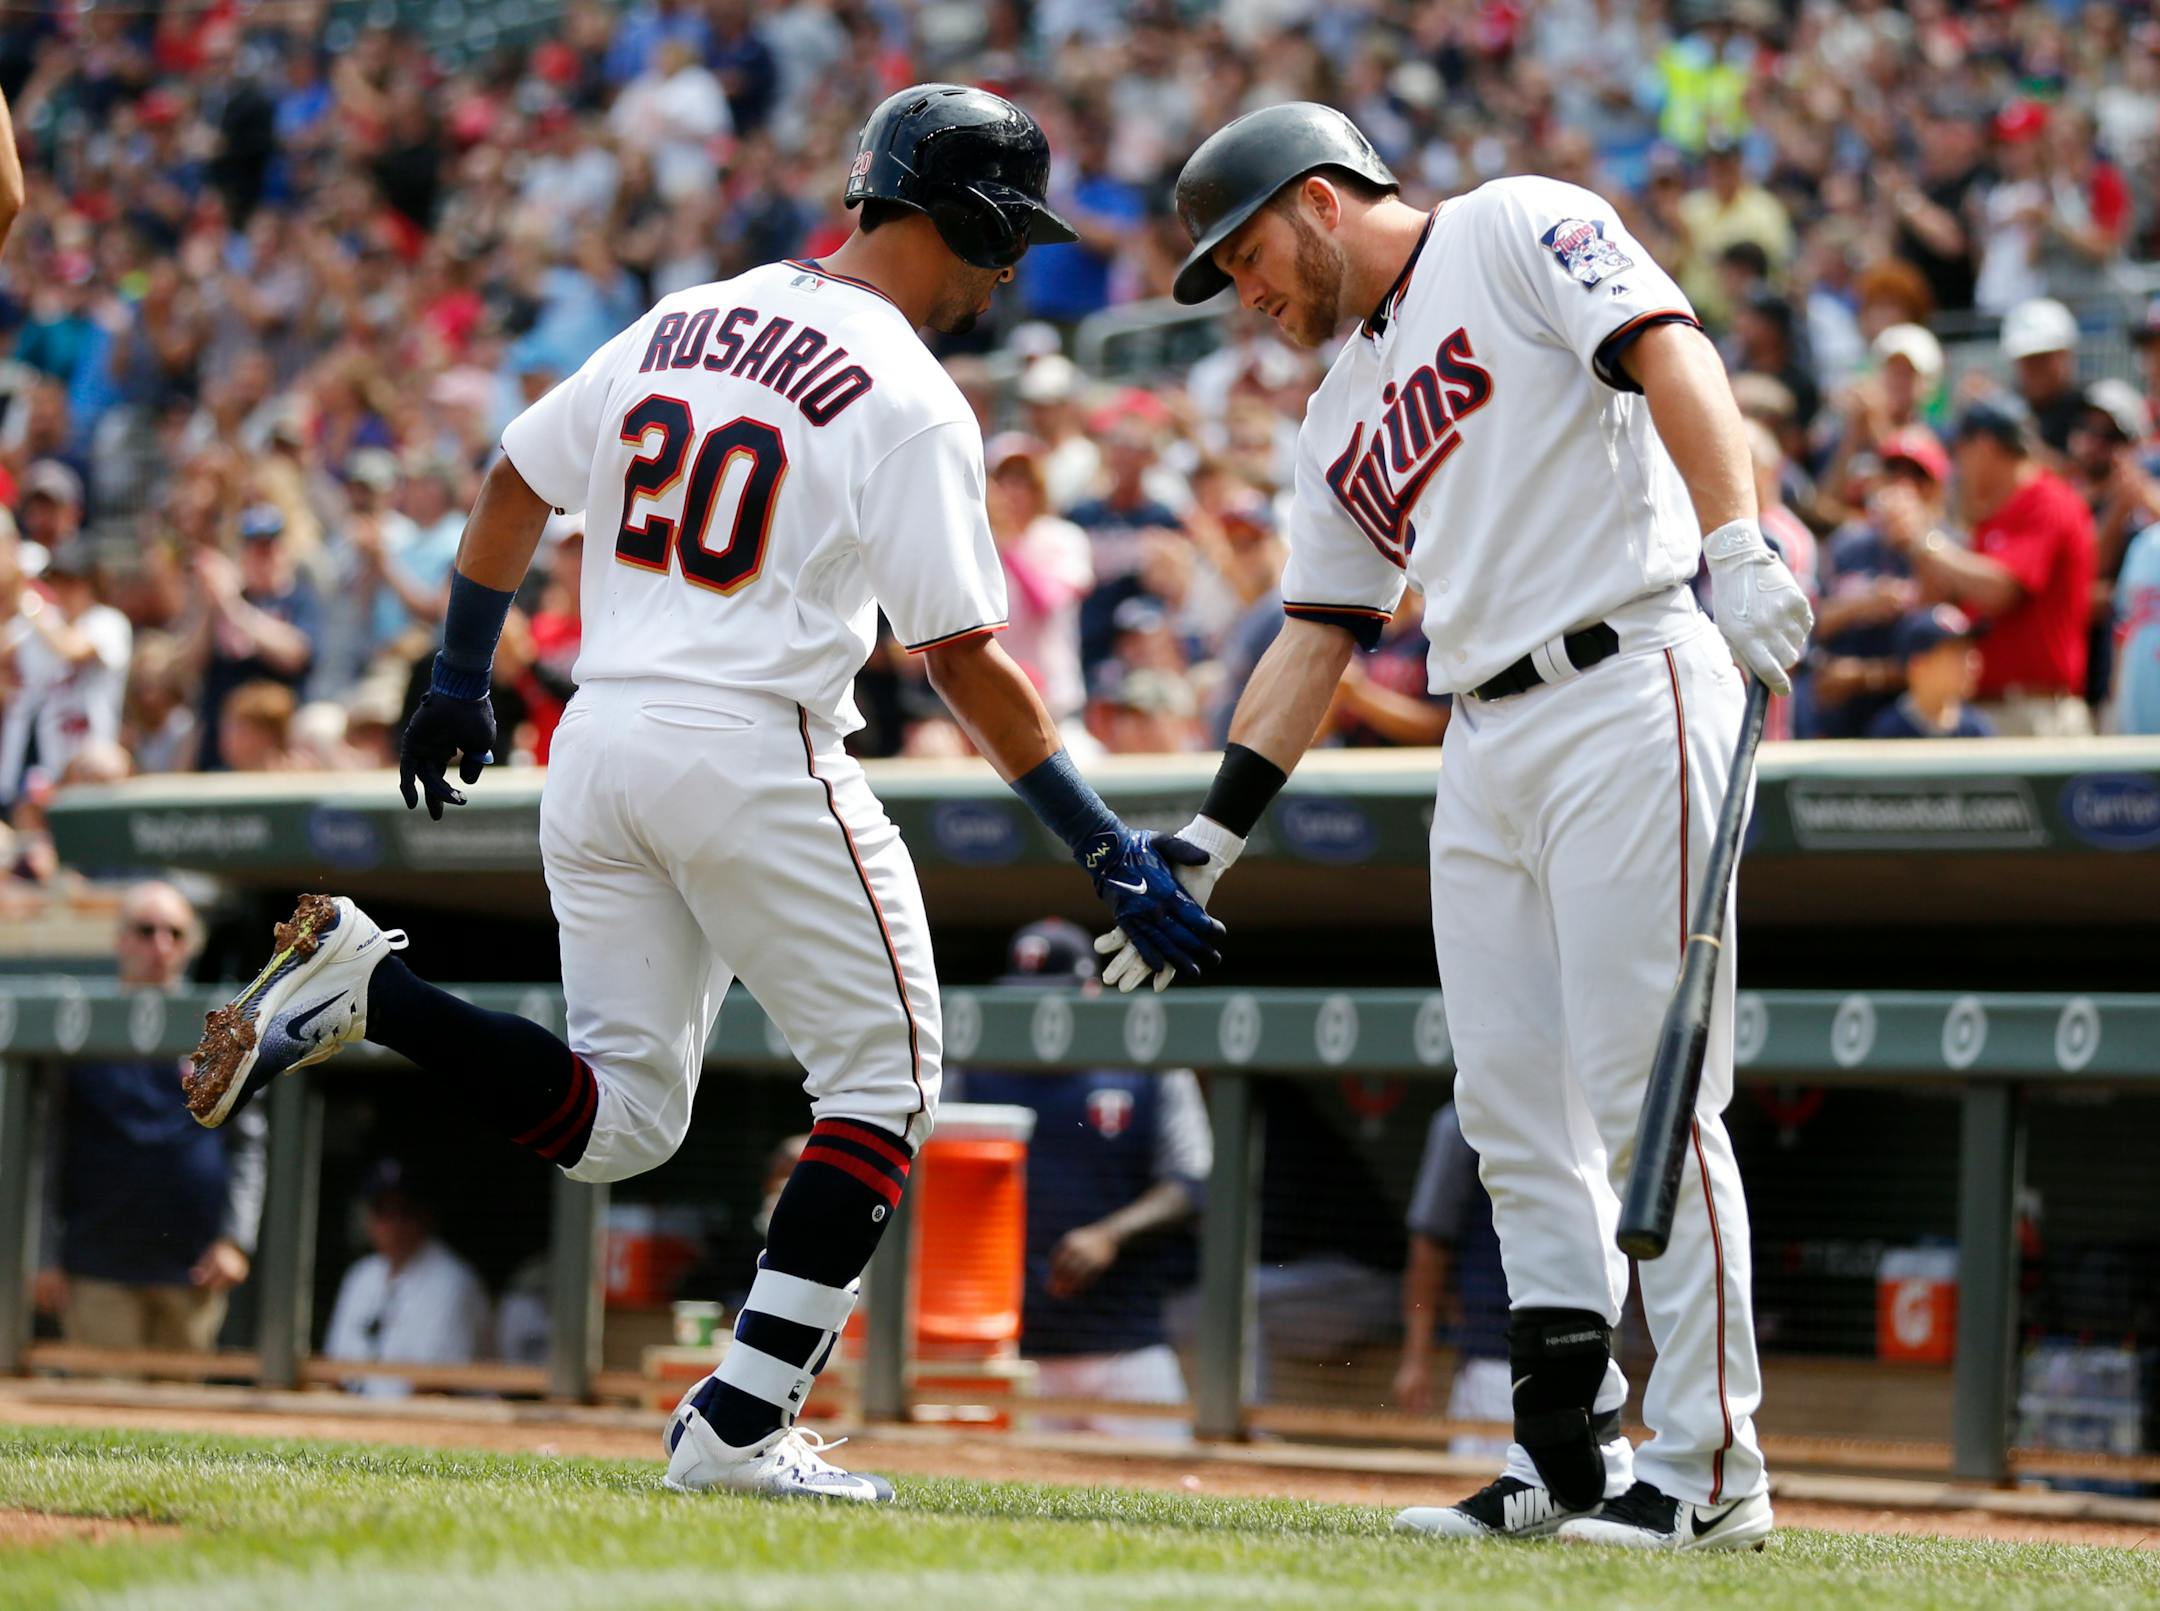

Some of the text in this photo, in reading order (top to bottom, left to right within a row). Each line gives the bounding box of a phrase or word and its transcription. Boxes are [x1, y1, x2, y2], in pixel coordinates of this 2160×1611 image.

[639, 307, 874, 427] ROSARIO
[1325, 327, 1494, 569] Twins
[615, 393, 790, 598] 20
[1503, 1487, 1561, 1533] NIK
